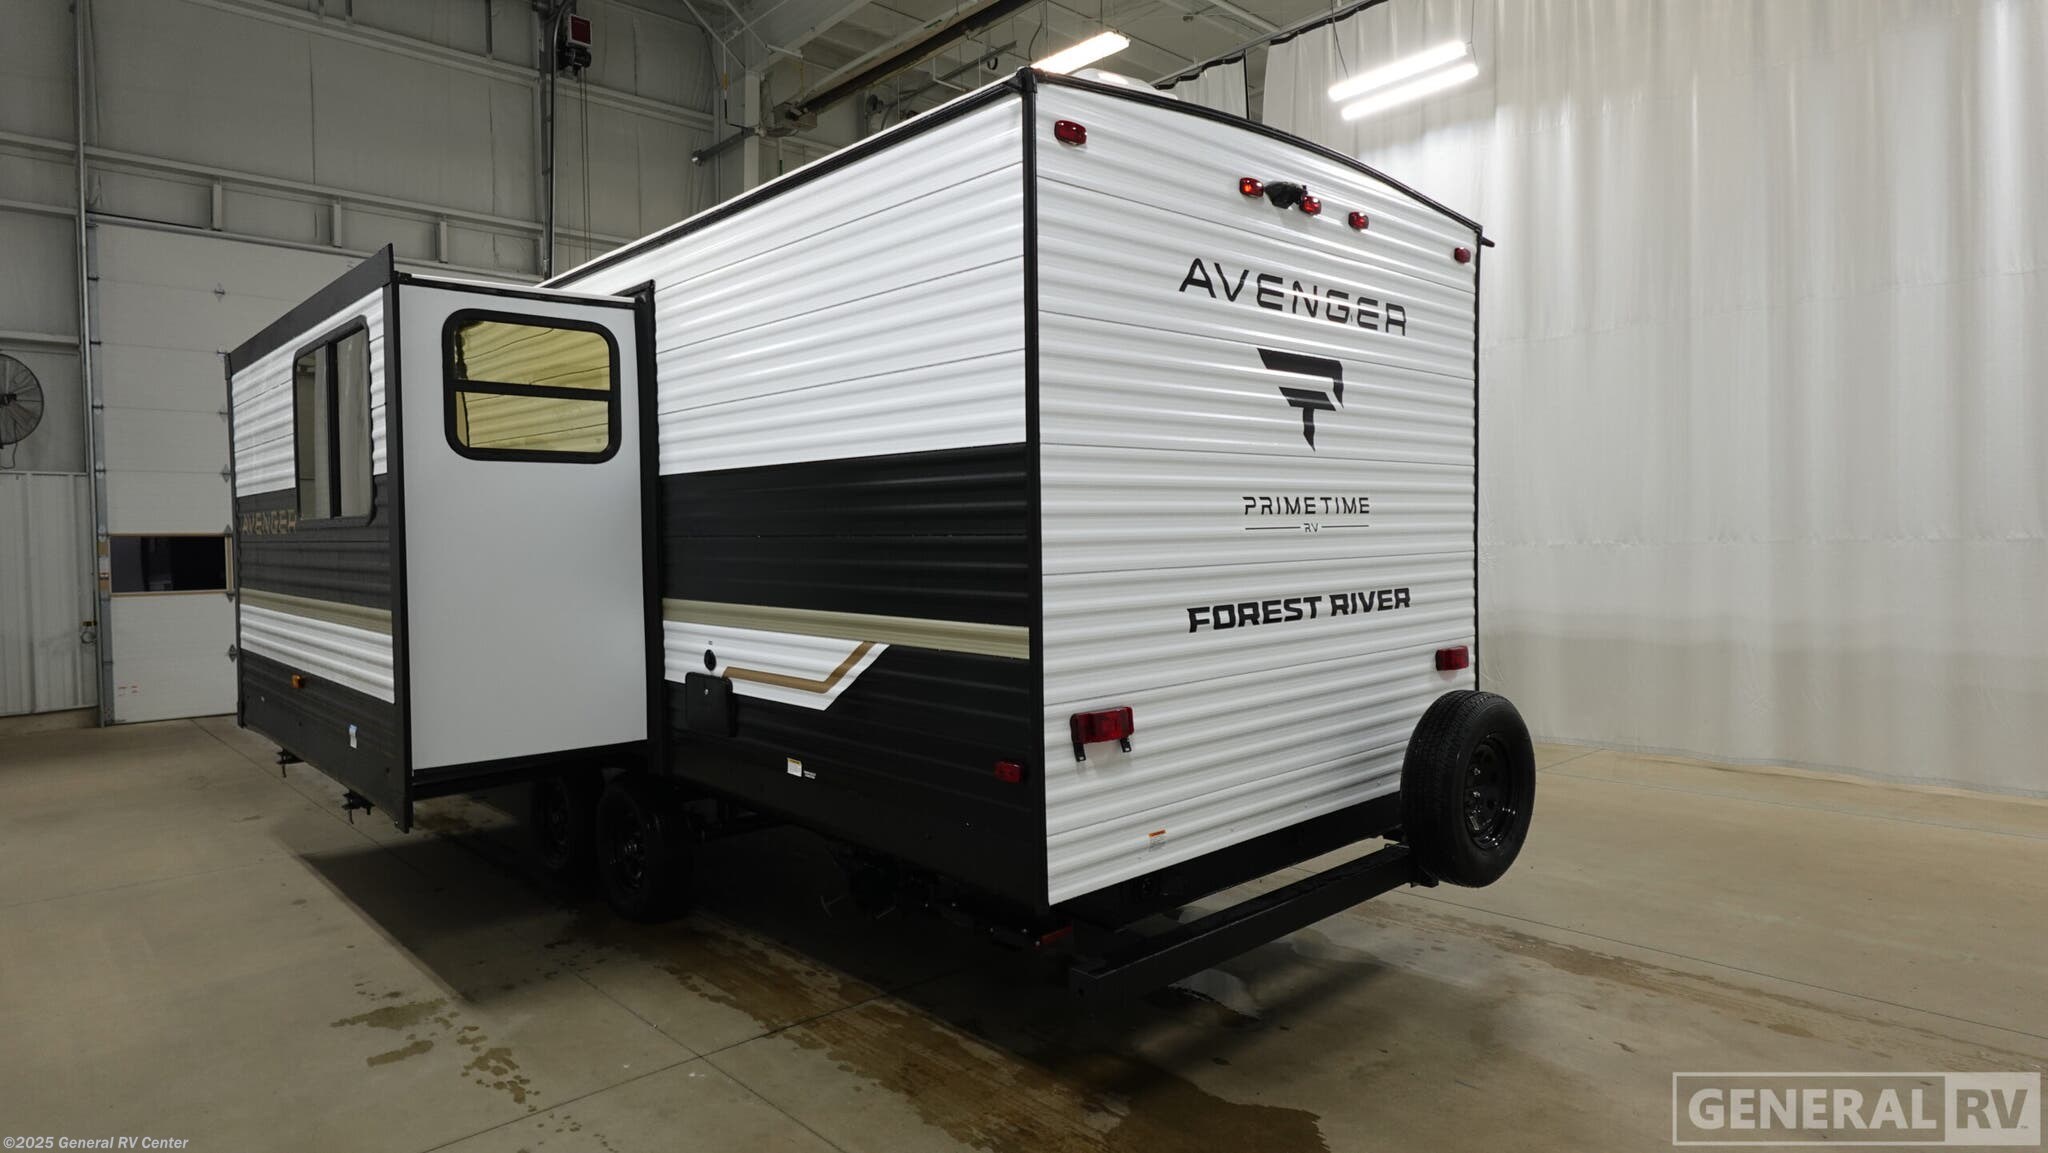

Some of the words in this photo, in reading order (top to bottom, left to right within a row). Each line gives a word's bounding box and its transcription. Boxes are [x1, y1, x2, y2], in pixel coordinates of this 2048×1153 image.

[1179, 258, 1406, 336] AVENGER
[241, 508, 297, 535] AVENGER
[1303, 523, 1319, 533] RV
[1187, 596, 1322, 633] FOREST
[1329, 588, 1411, 617] RIVER
